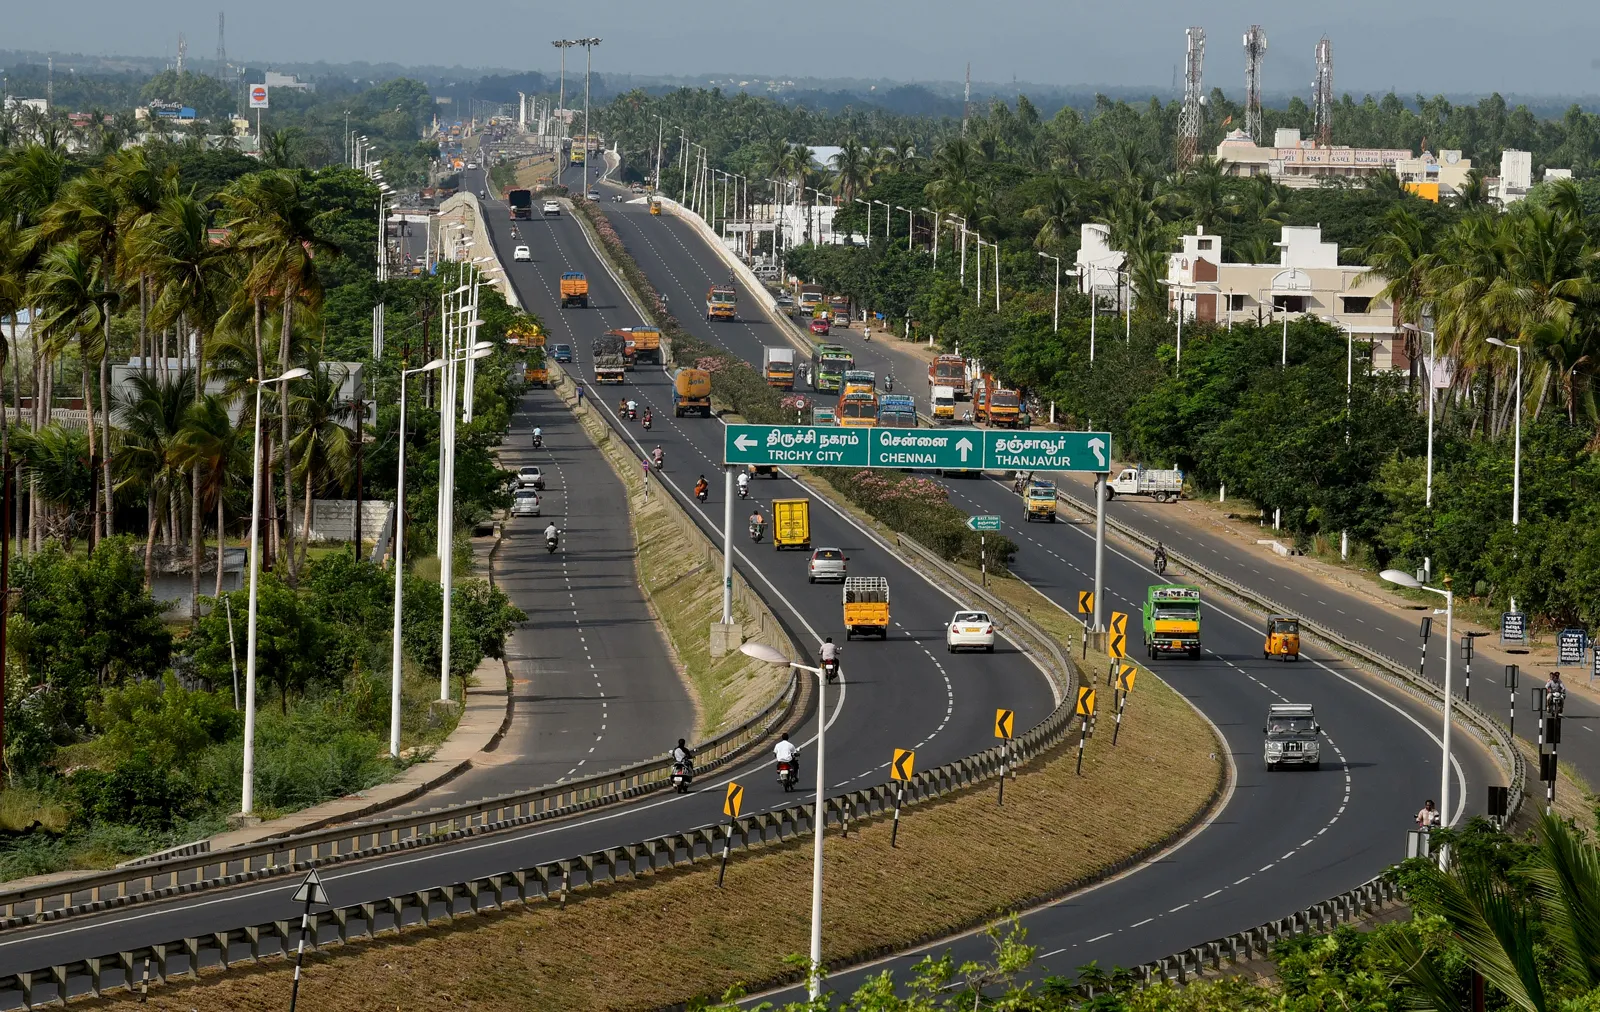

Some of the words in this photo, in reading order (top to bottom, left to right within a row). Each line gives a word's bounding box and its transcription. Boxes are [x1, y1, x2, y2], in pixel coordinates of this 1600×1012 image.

[766, 429, 816, 447] திருச்சி
[819, 431, 859, 448] நகரம்
[880, 431, 948, 447] சென்னை
[995, 434, 1066, 455] தஞ்சாவூர்
[768, 450, 813, 460] TRICHY
[816, 451, 844, 461] CITY
[880, 452, 936, 463] CHENNAI
[995, 455, 1071, 466] THANJAVUR
